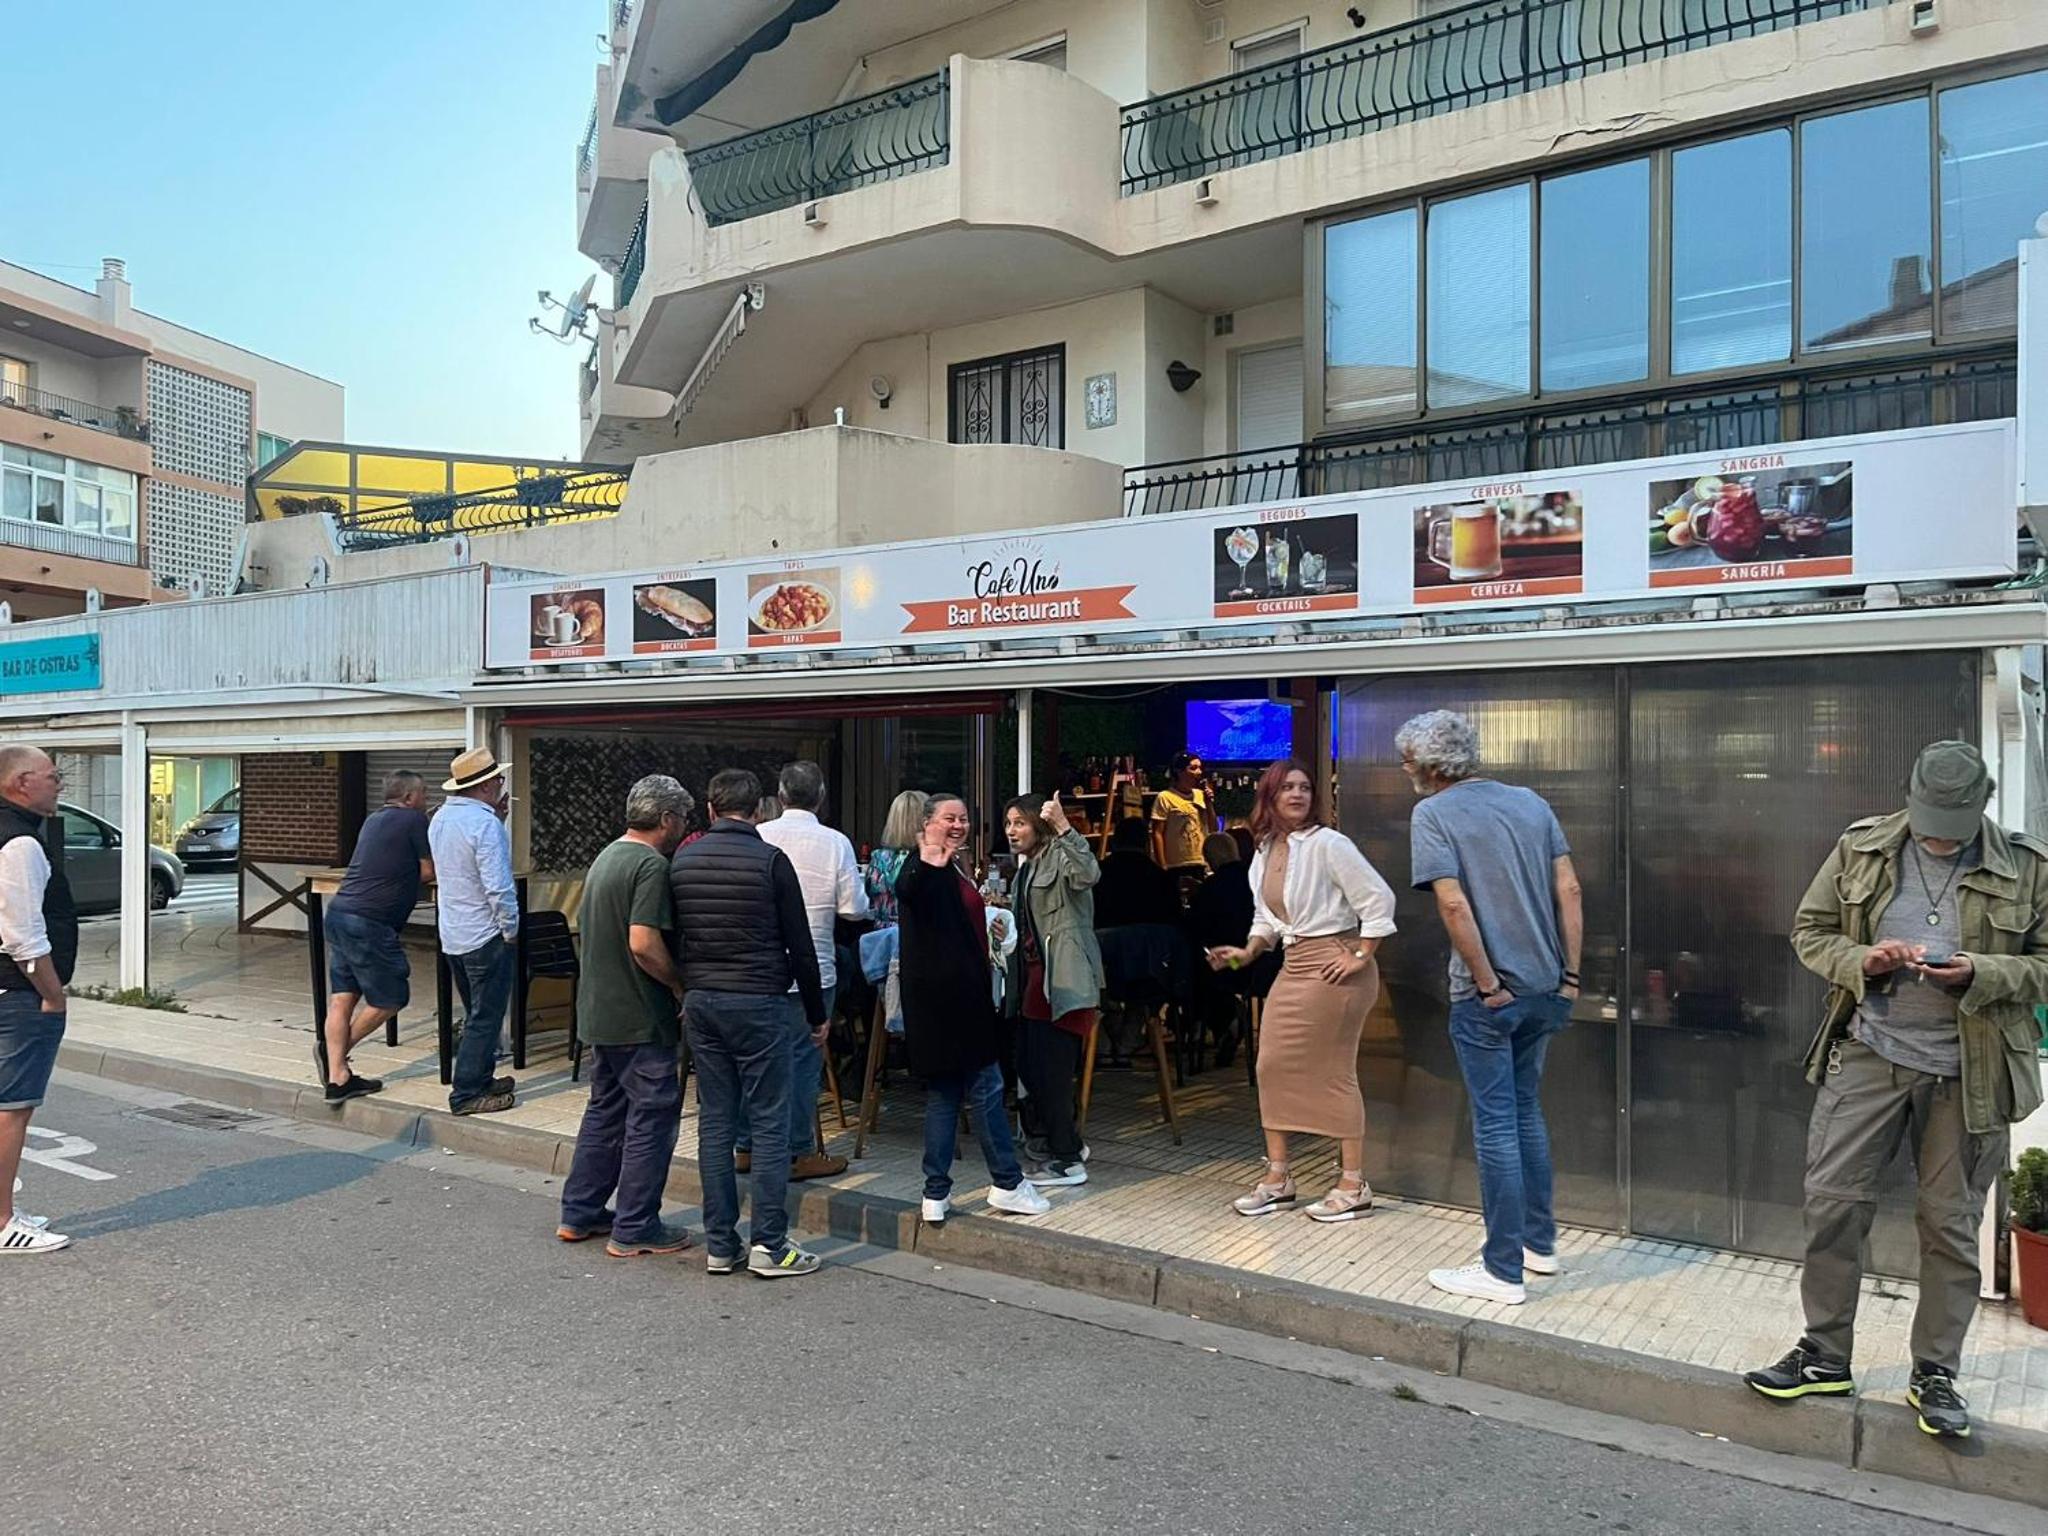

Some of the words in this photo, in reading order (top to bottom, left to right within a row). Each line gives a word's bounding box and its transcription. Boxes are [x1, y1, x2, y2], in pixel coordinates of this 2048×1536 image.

[1471, 482, 1523, 499] CERVESA
[1260, 508, 1306, 522] BEGUDES
[967, 561, 1018, 605] Café
[1013, 557, 1060, 597] Uno
[1471, 582, 1524, 597] CERVEZA
[948, 604, 977, 626] Bar
[980, 597, 1081, 624] Restaurant
[1256, 599, 1312, 613] COCKTAILS
[783, 634, 804, 644] TAPAS
[3, 660, 21, 678] BAR
[24, 658, 37, 676] DE
[39, 654, 80, 675] OSTRAS
